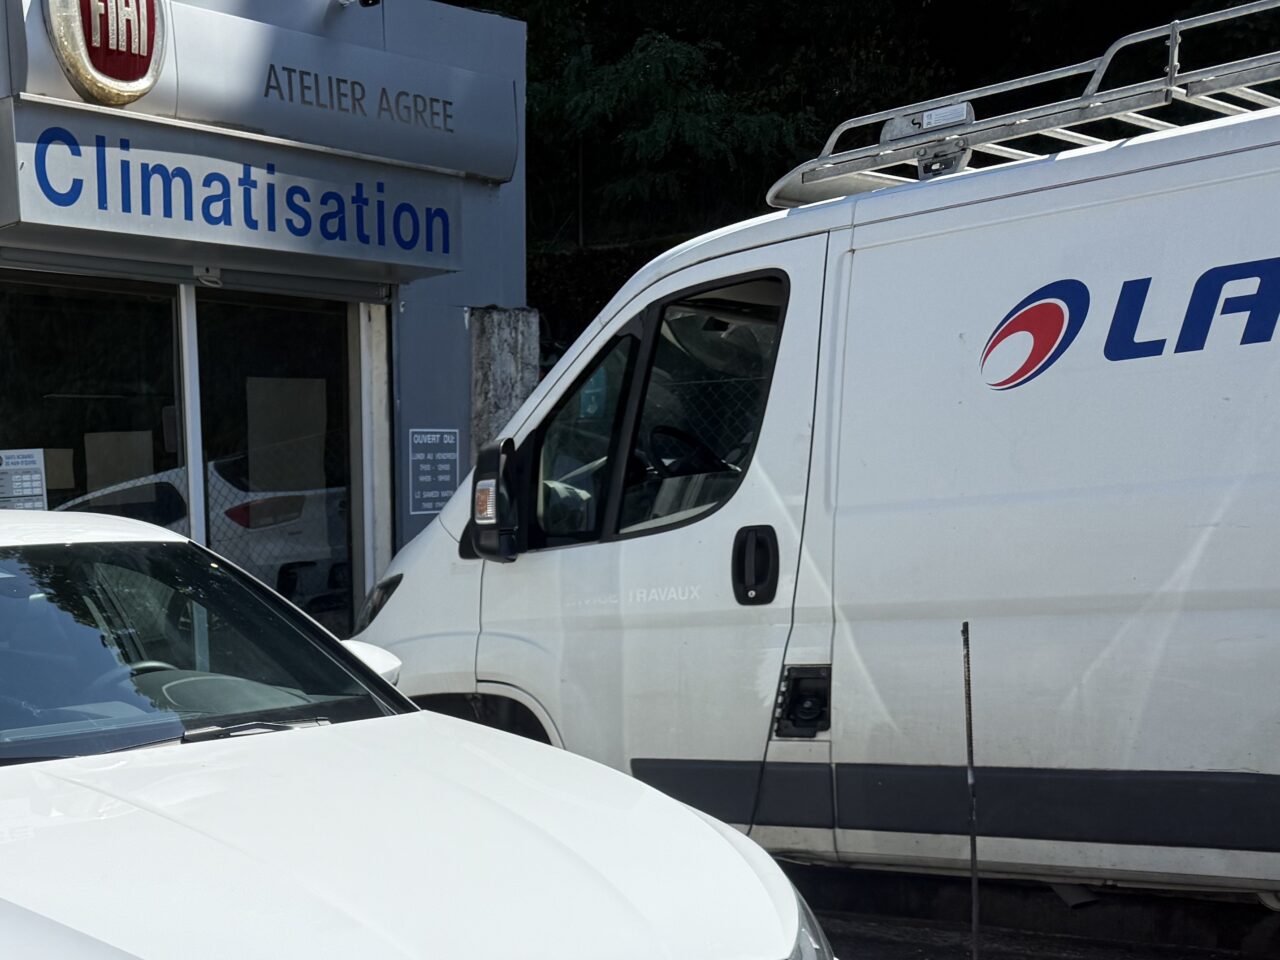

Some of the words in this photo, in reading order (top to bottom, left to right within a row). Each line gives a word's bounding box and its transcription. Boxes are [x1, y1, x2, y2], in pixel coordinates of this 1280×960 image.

[263, 63, 368, 118] ATELIER
[377, 86, 455, 134] AGREE
[34, 126, 452, 255] Climatisation
[1103, 256, 1280, 362] LA
[413, 434, 441, 444] OUVERT
[628, 585, 701, 602] TRAVAUX
